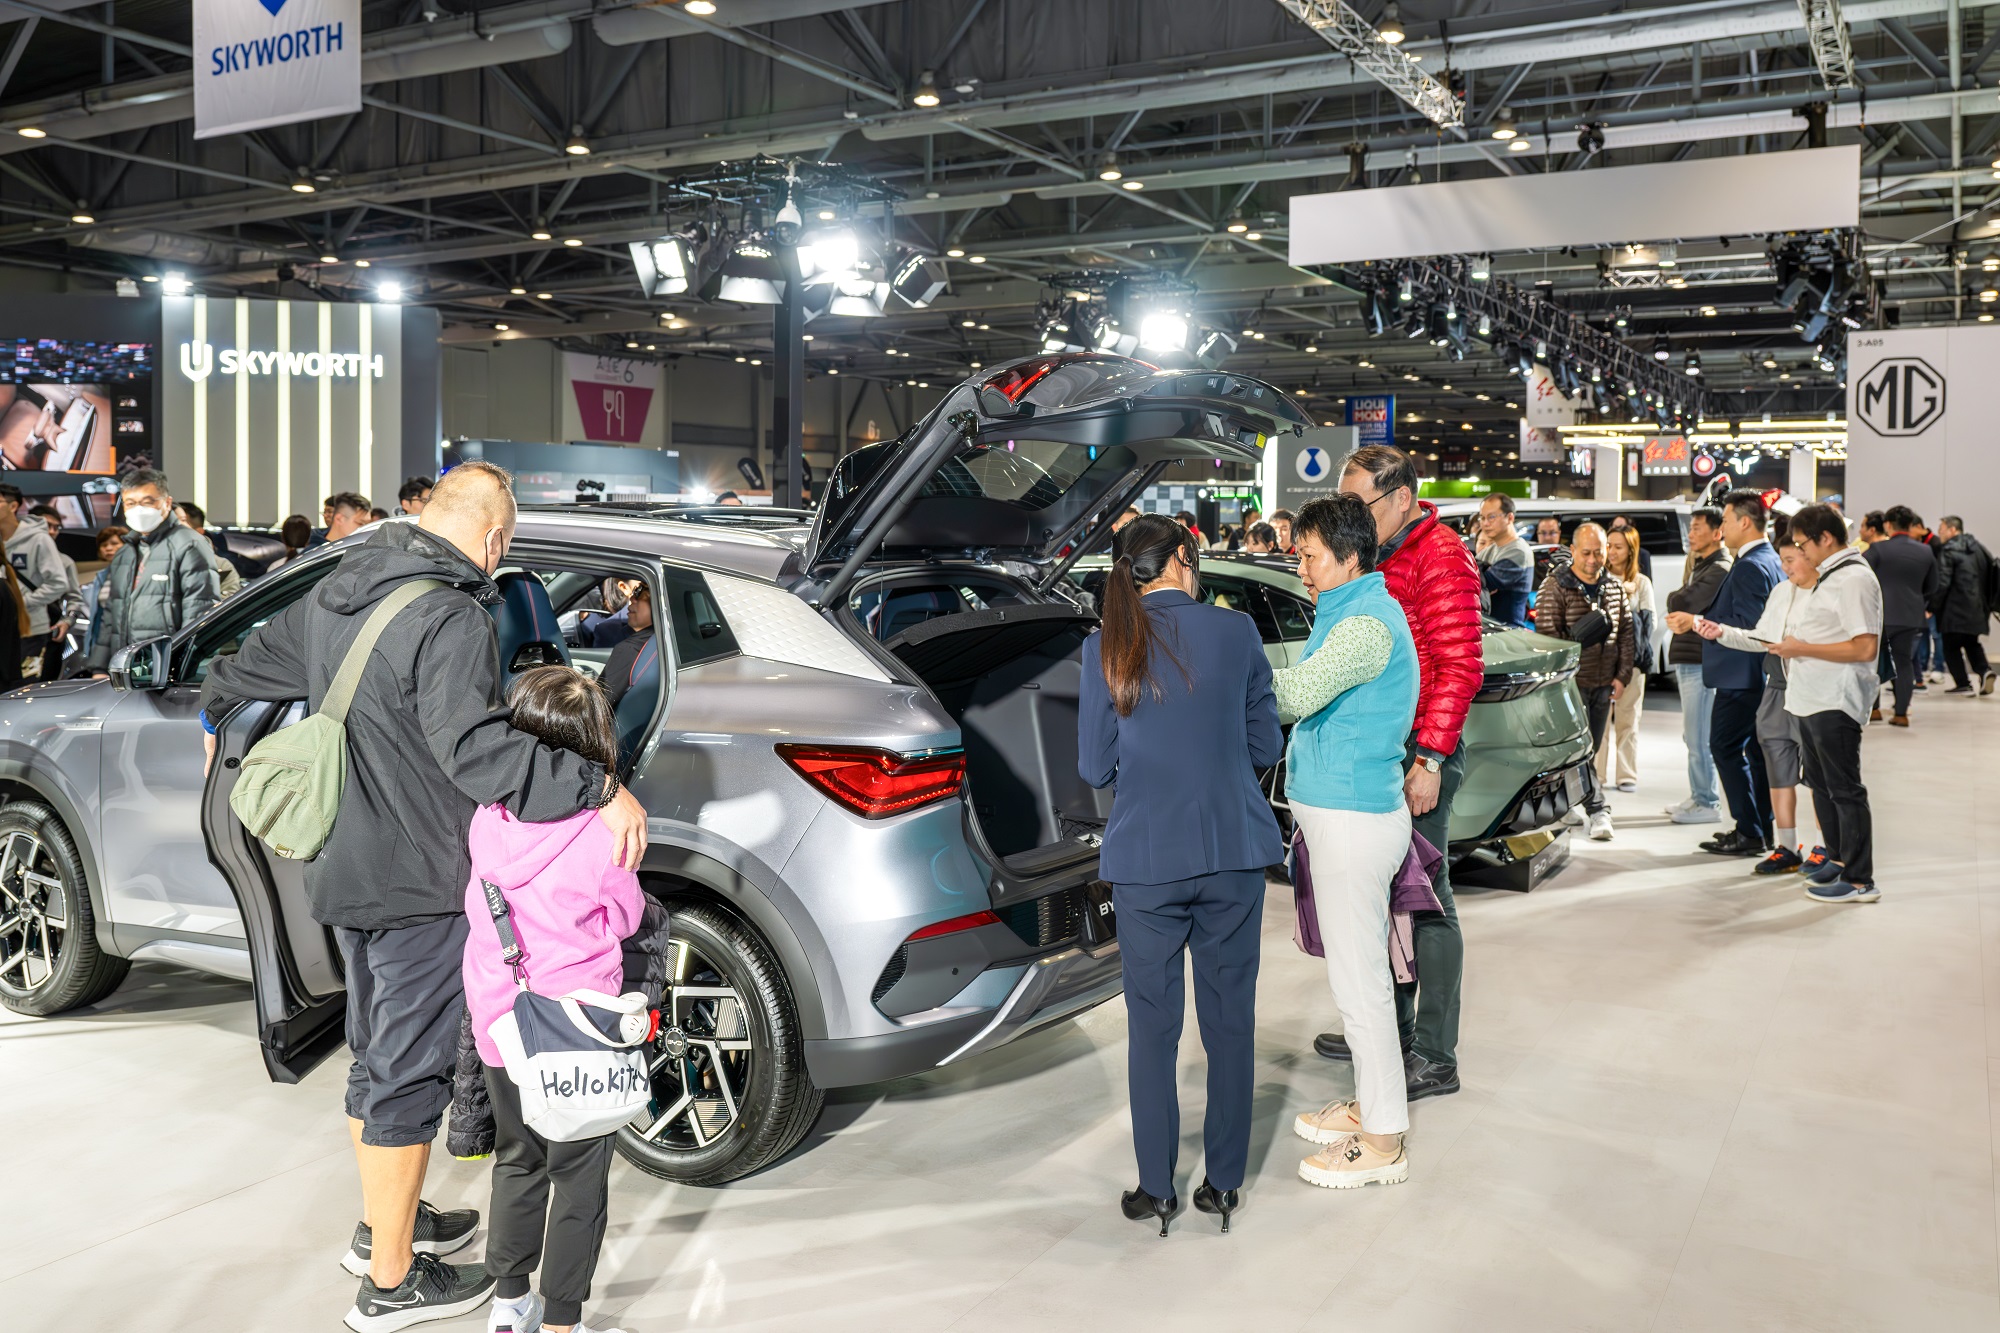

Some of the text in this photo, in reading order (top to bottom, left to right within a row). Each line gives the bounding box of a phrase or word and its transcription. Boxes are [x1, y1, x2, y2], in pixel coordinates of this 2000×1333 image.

[212, 21, 343, 76] SKYWORTH
[1857, 339, 1884, 348] 3-A05
[219, 349, 384, 378] SKYWORTH
[1356, 399, 1385, 410] LIQUI
[1865, 365, 1937, 430] MG
[1355, 410, 1386, 421] MOLY
[1099, 900, 1114, 917] BY
